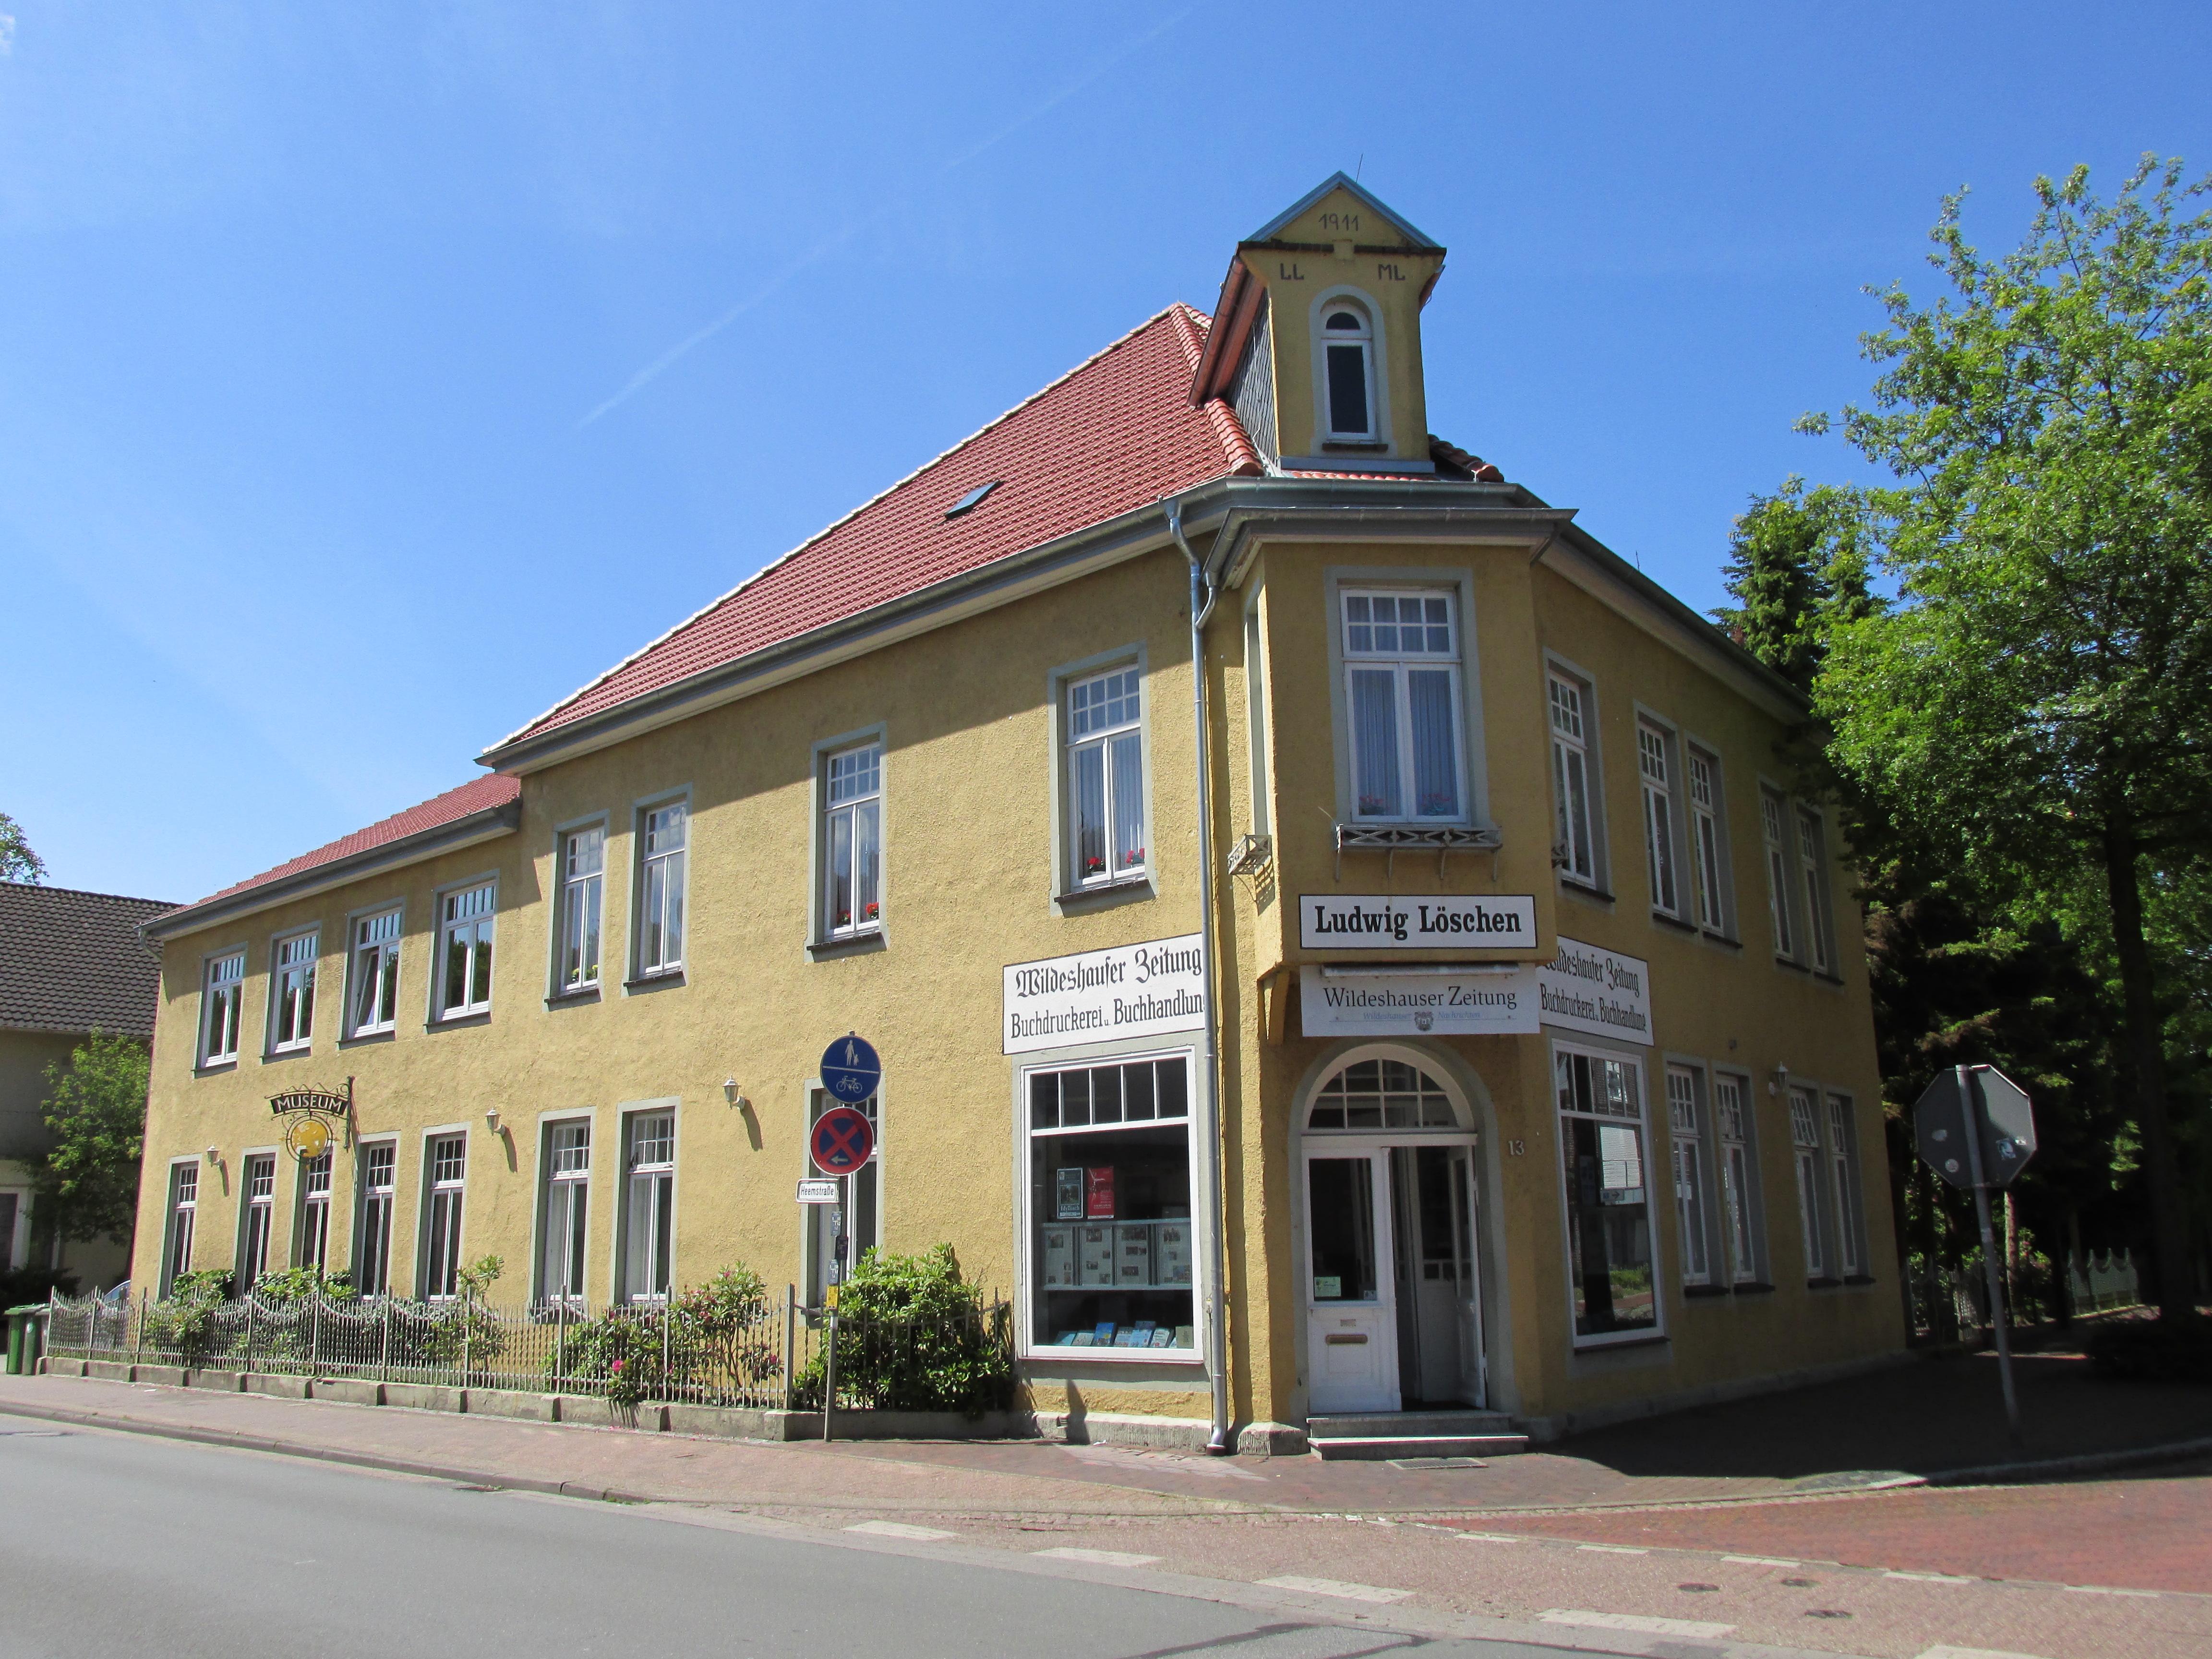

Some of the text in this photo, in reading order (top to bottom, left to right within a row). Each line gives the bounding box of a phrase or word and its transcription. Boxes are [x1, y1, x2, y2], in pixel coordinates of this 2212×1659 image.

[1319, 213, 1358, 231] 1911
[1280, 263, 1304, 280] LL
[1378, 264, 1405, 281] ML
[1315, 905, 1522, 940] Ludwig Löschen
[1135, 946, 1202, 984] Zeitung
[1606, 958, 1639, 998] Zeitung
[1323, 986, 1517, 1010] Wildeshauser Zeitung
[1539, 983, 1595, 1021] Buchdruckerei
[1011, 1006, 1103, 1038] Buchdruckerei
[1114, 989, 1205, 1025] Buchhandlun
[276, 1094, 342, 1113] MUSEUM
[1508, 1140, 1525, 1156] 13
[801, 1185, 834, 1195] Heemstraße
